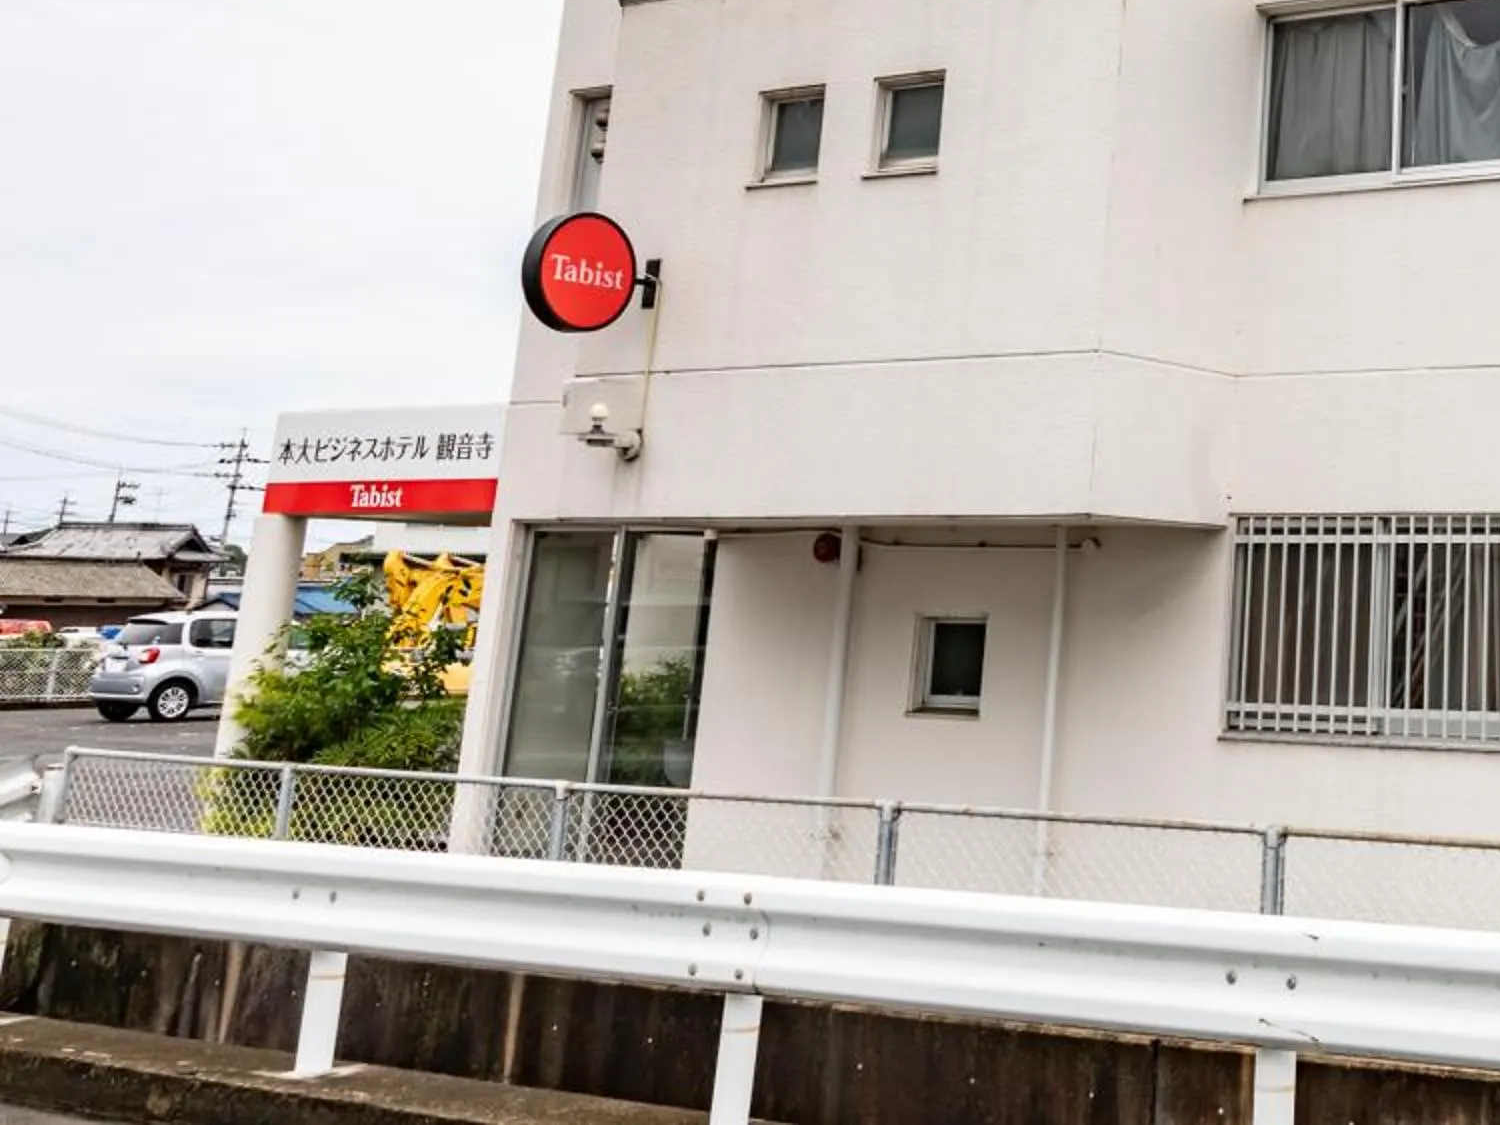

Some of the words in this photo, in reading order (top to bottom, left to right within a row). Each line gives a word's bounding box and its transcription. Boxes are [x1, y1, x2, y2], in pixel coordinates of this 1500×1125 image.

[552, 253, 625, 290] Tabist
[278, 433, 429, 466] 本大ビジネスホテル
[435, 431, 494, 462] 観音寺
[350, 483, 403, 508] Tabist
